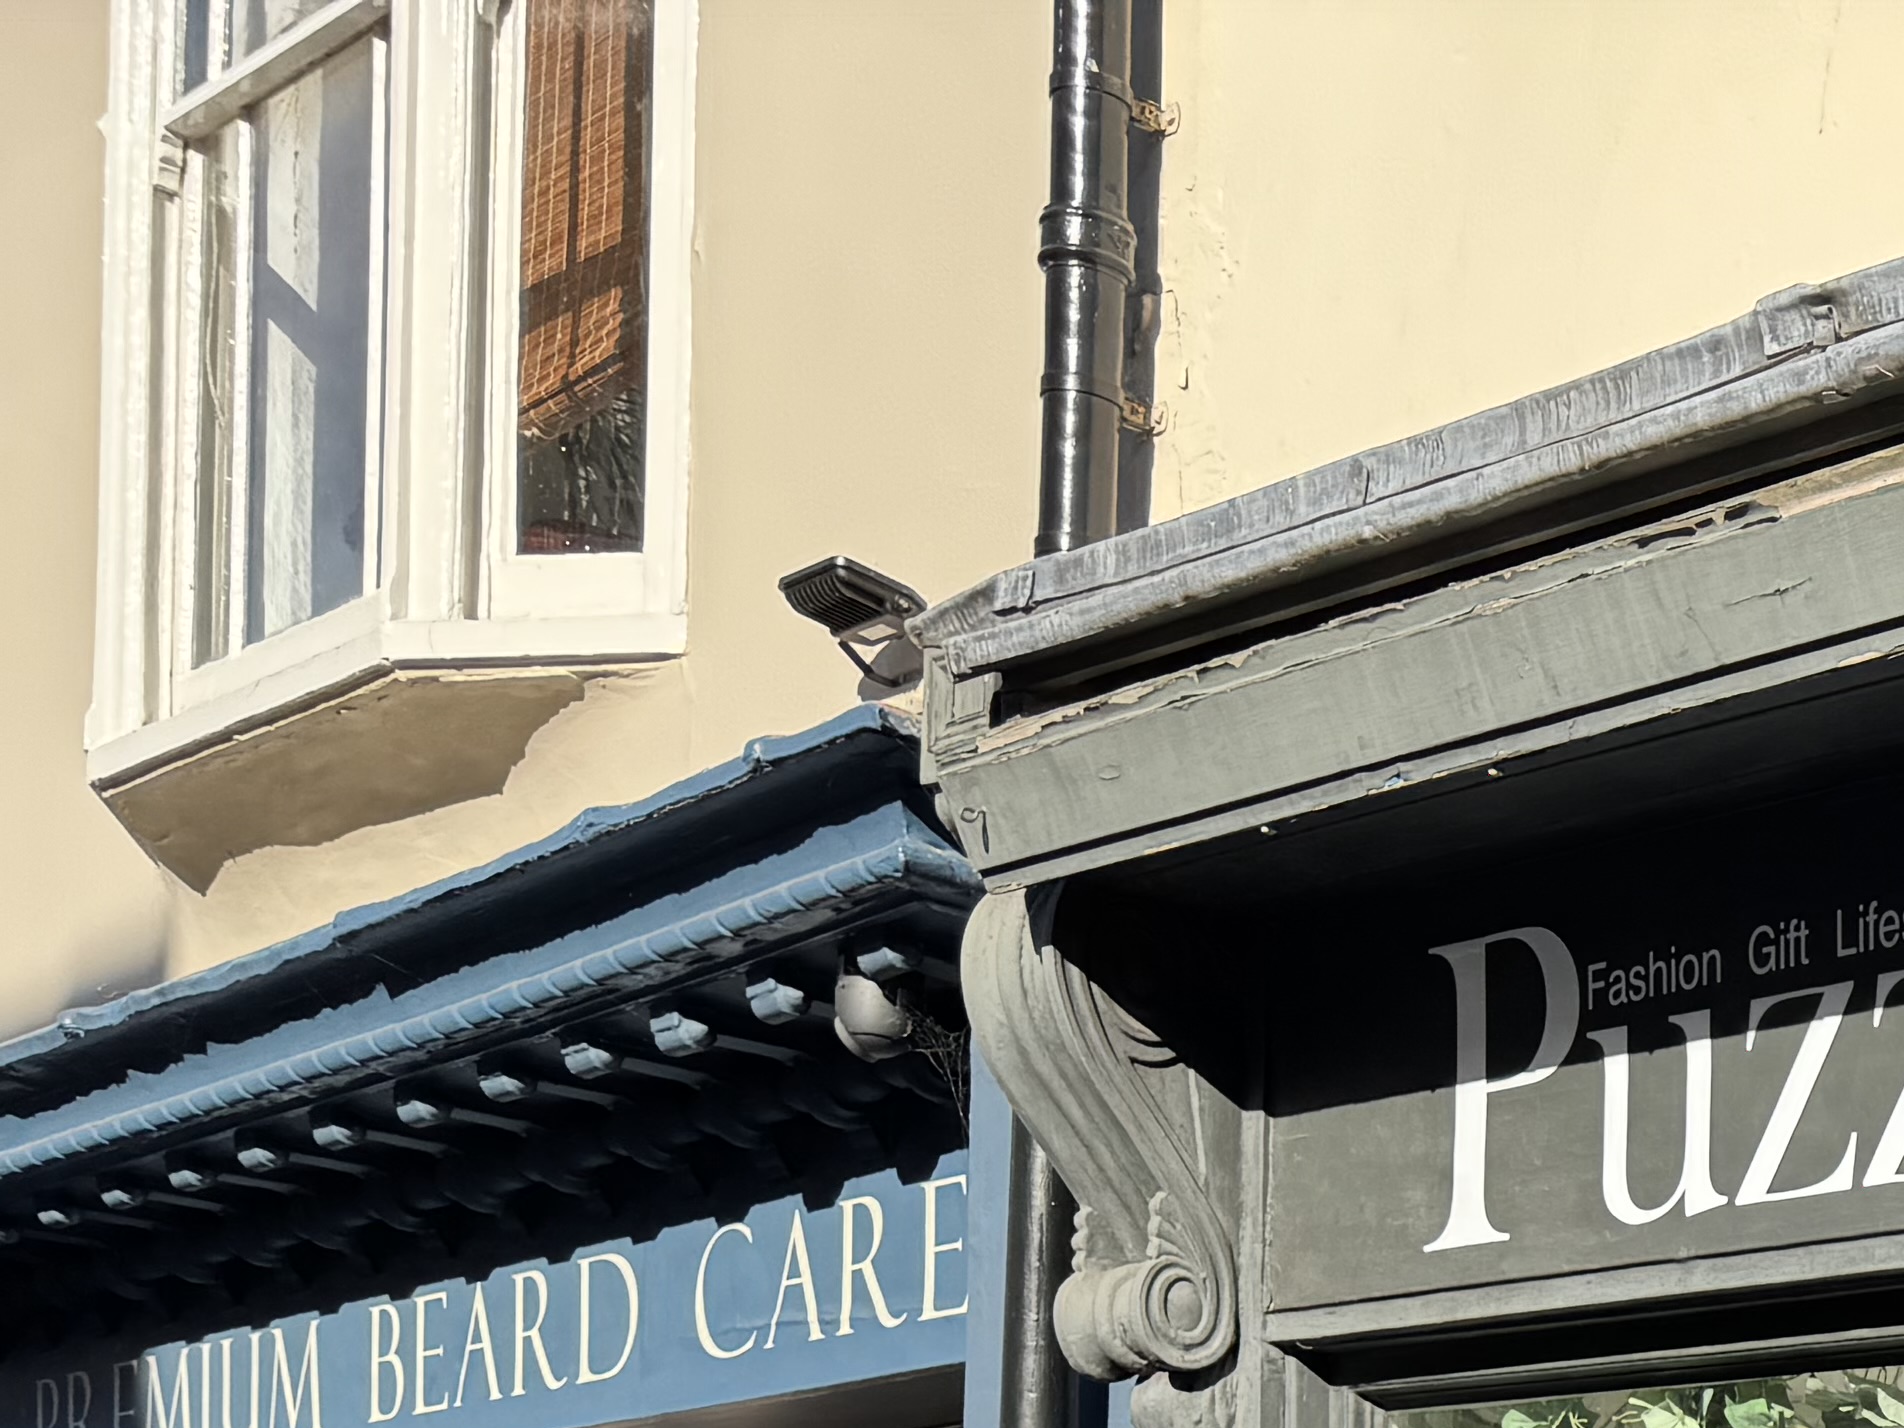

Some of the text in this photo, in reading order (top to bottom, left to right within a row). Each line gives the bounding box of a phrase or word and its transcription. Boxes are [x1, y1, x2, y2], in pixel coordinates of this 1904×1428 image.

[1588, 945, 1721, 1010] Fashion
[1749, 918, 1809, 975] Gift
[367, 1251, 642, 1425] BEARD
[693, 1173, 969, 1360] CARE
